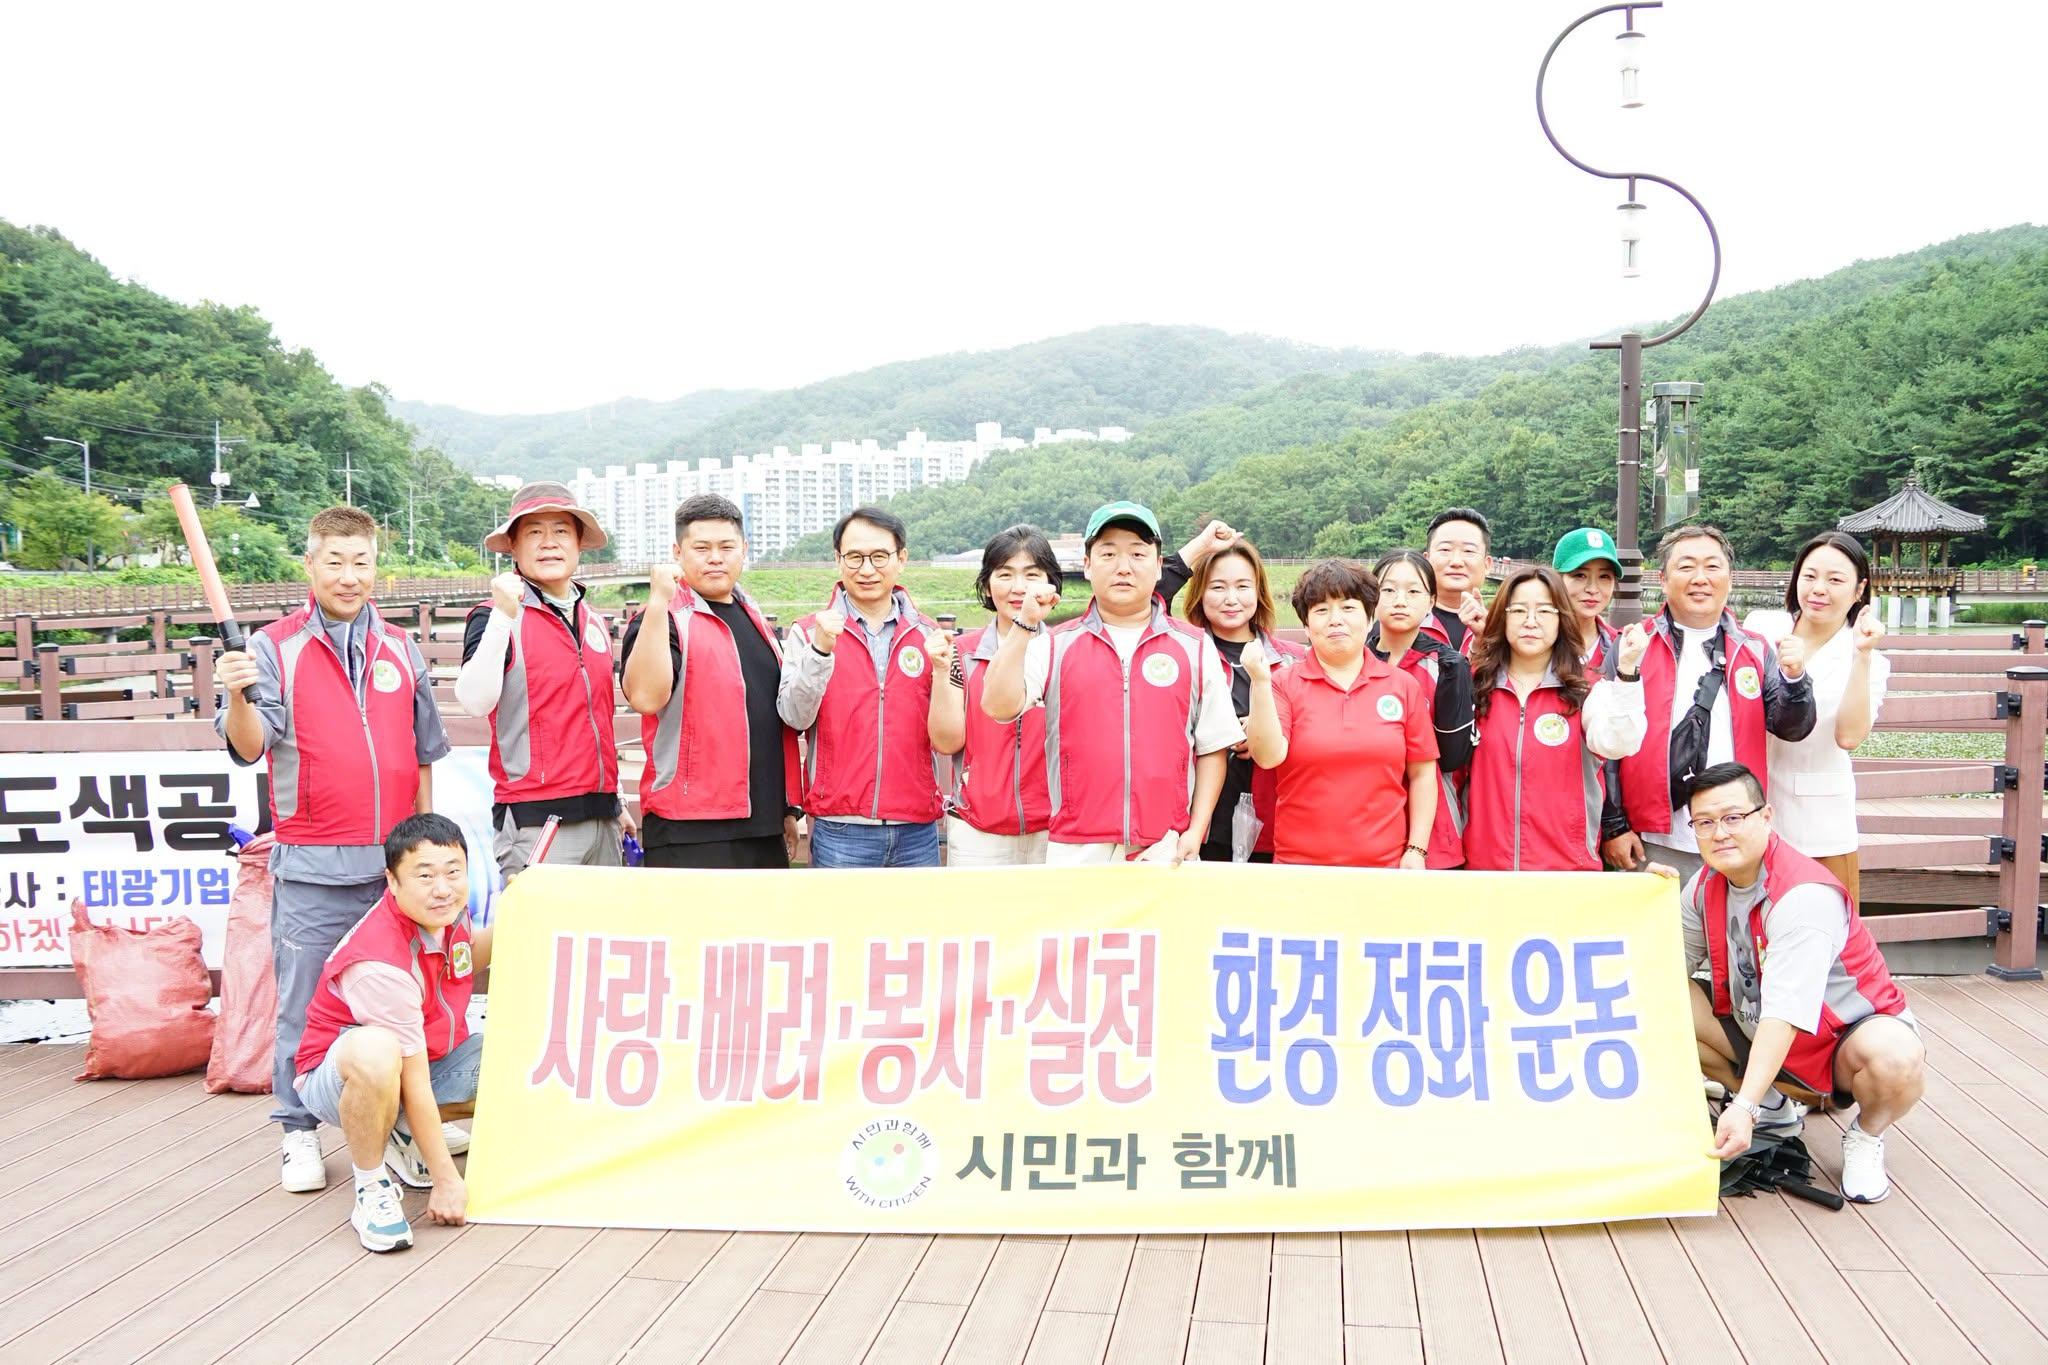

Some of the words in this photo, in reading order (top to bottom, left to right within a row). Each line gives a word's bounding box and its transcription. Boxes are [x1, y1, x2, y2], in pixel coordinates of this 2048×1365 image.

[0, 773, 273, 854] 도색공
[0, 871, 41, 908] 사
[83, 868, 230, 907] 태광기업
[1211, 932, 1338, 1106] 환경
[1362, 941, 1490, 1107] 정화
[1511, 938, 1638, 1101] 운동
[846, 1175, 876, 1207] WITH
[878, 1175, 932, 1209] CITIZEN
[955, 1132, 1147, 1192] 시민과
[1172, 1132, 1297, 1190] 함께
